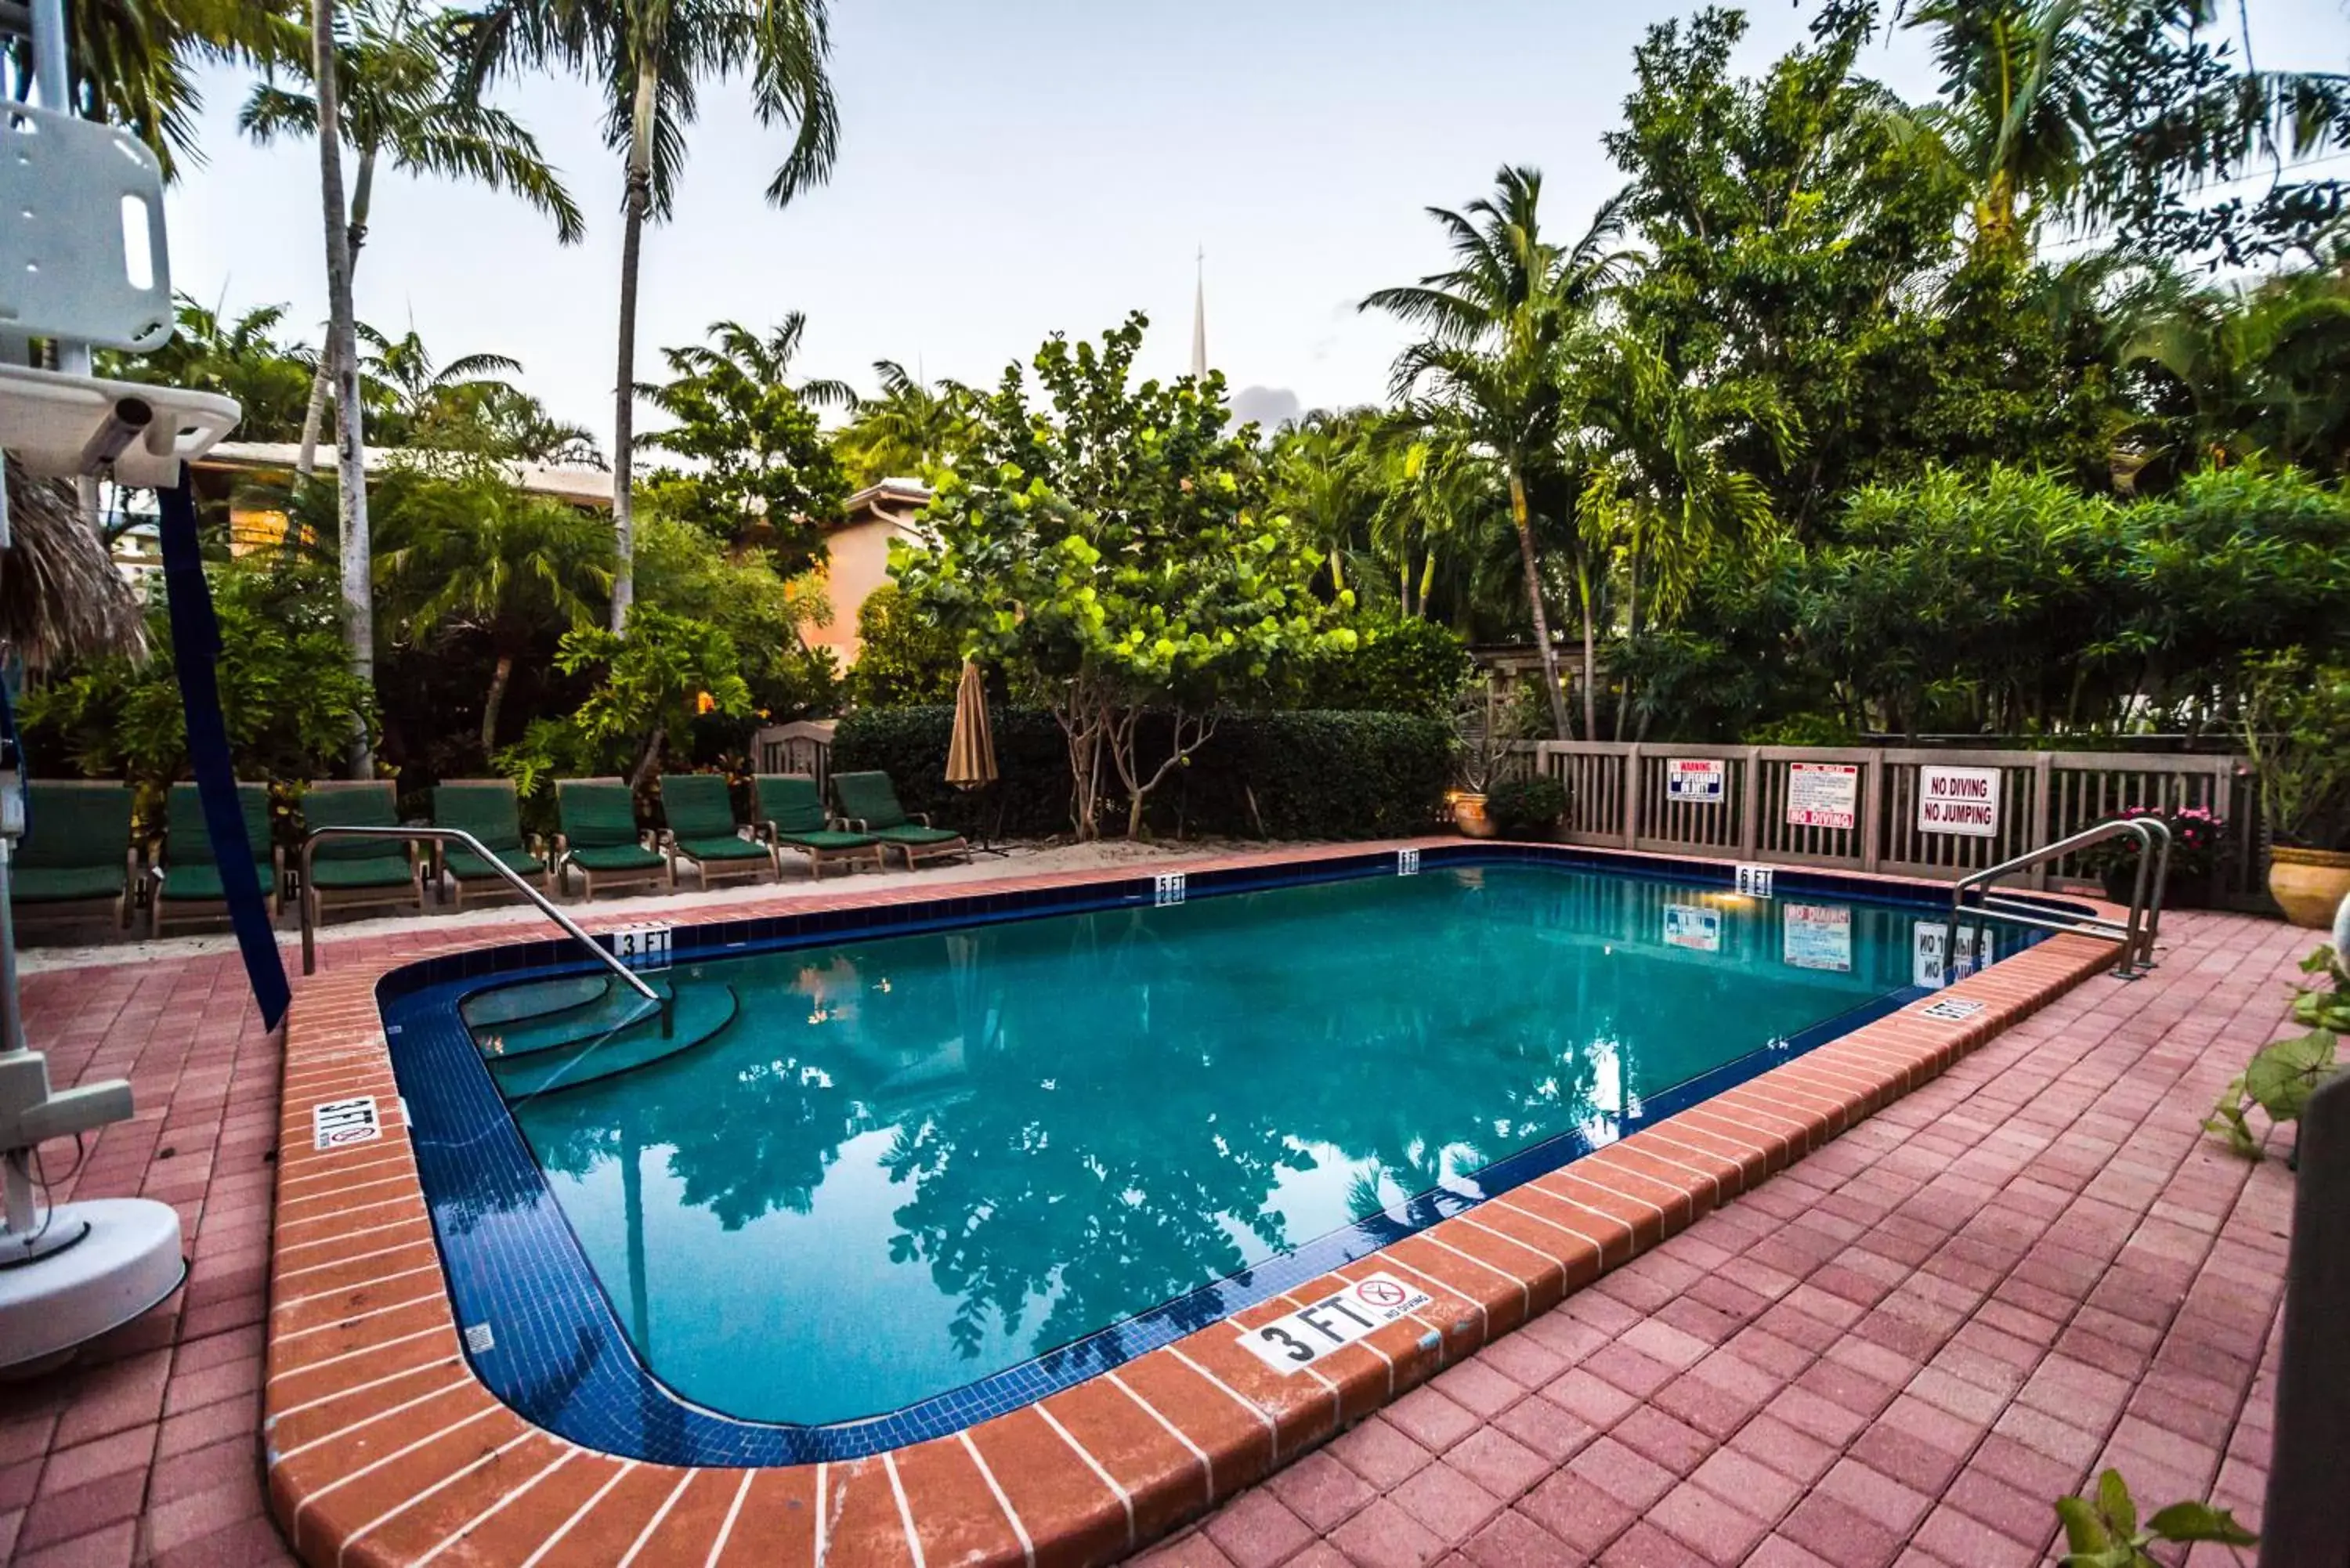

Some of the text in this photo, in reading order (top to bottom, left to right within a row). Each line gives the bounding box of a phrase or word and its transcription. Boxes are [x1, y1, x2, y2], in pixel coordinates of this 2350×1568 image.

[1931, 777, 1987, 797] NO DIVING
[1790, 810, 1806, 824] NO
[1924, 803, 1991, 825] NO JUMPING
[1160, 876, 1184, 891] 5 FT
[624, 930, 669, 955] 3 FT
[318, 1100, 374, 1130] 3 FT
[1260, 1296, 1376, 1363] 3 FT
